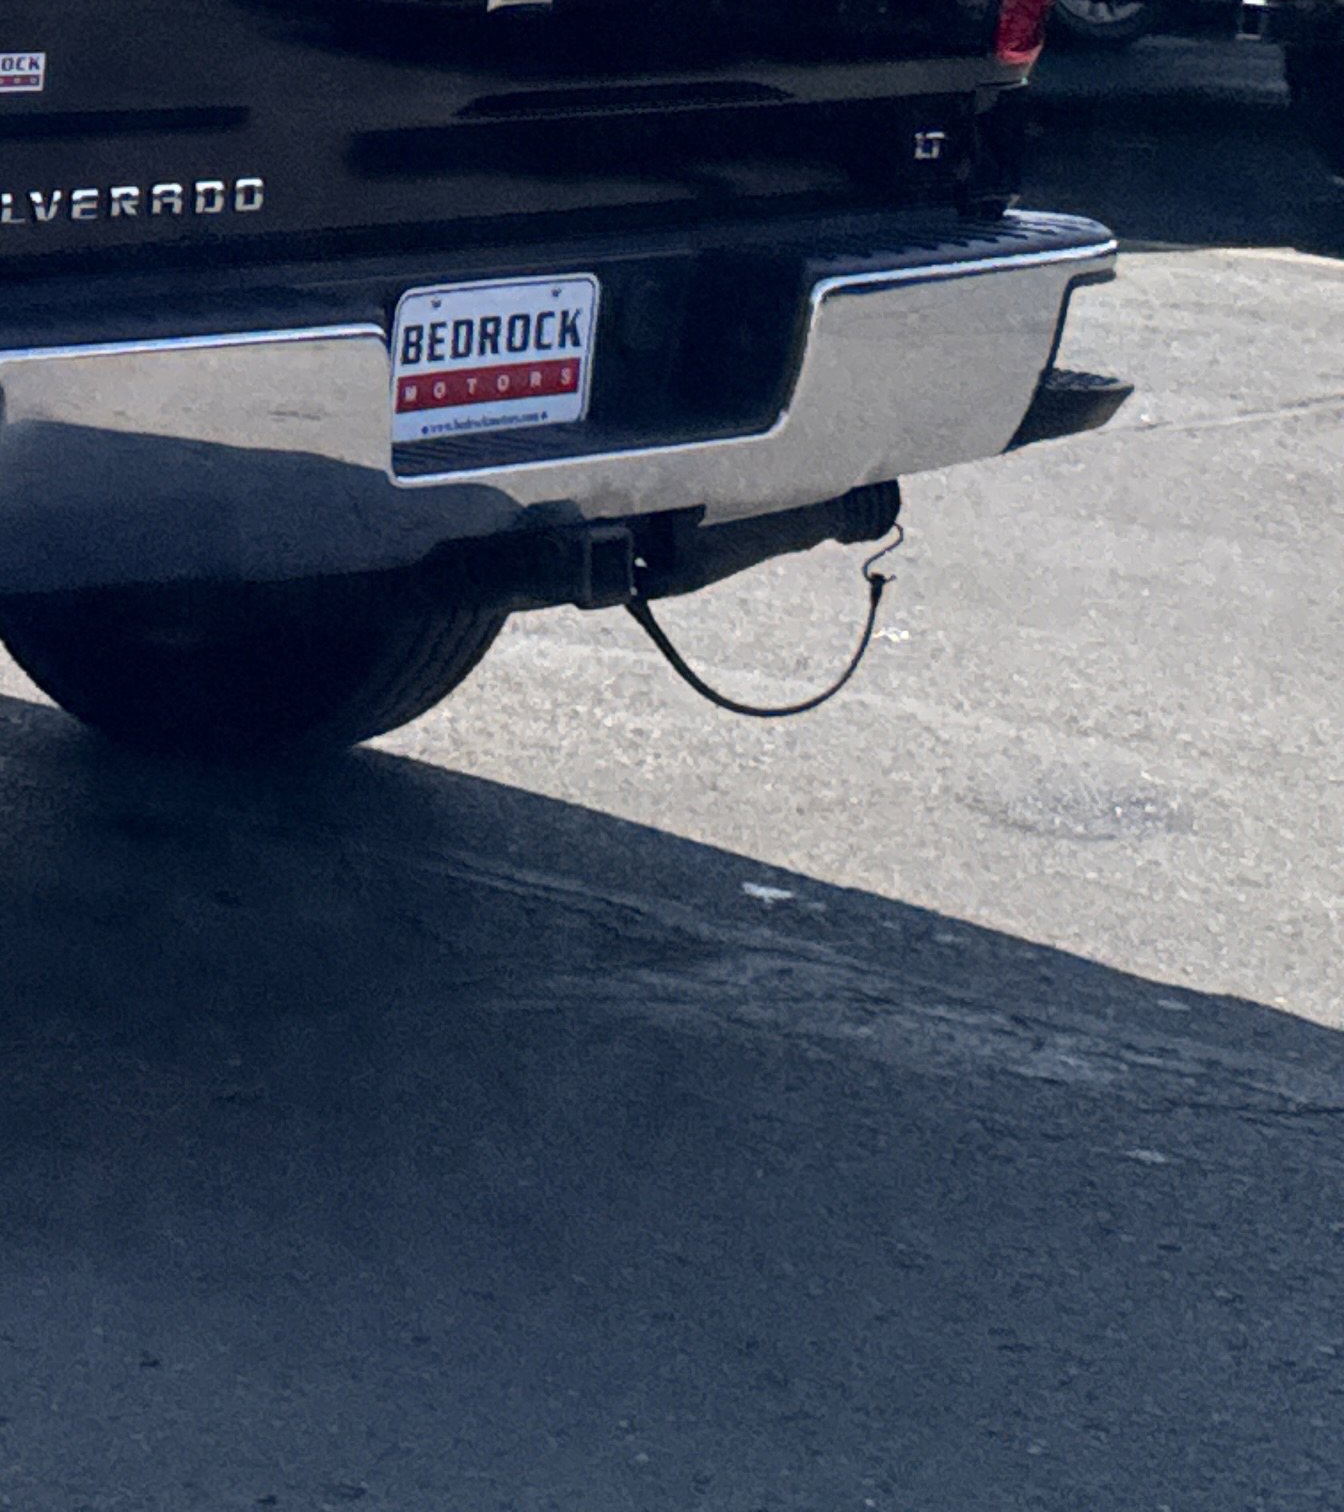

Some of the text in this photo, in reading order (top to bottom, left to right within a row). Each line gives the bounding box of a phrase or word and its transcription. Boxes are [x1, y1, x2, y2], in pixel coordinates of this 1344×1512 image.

[914, 131, 946, 160] LT
[400, 308, 582, 366] BEDROCK
[404, 368, 572, 402] MOTORS
